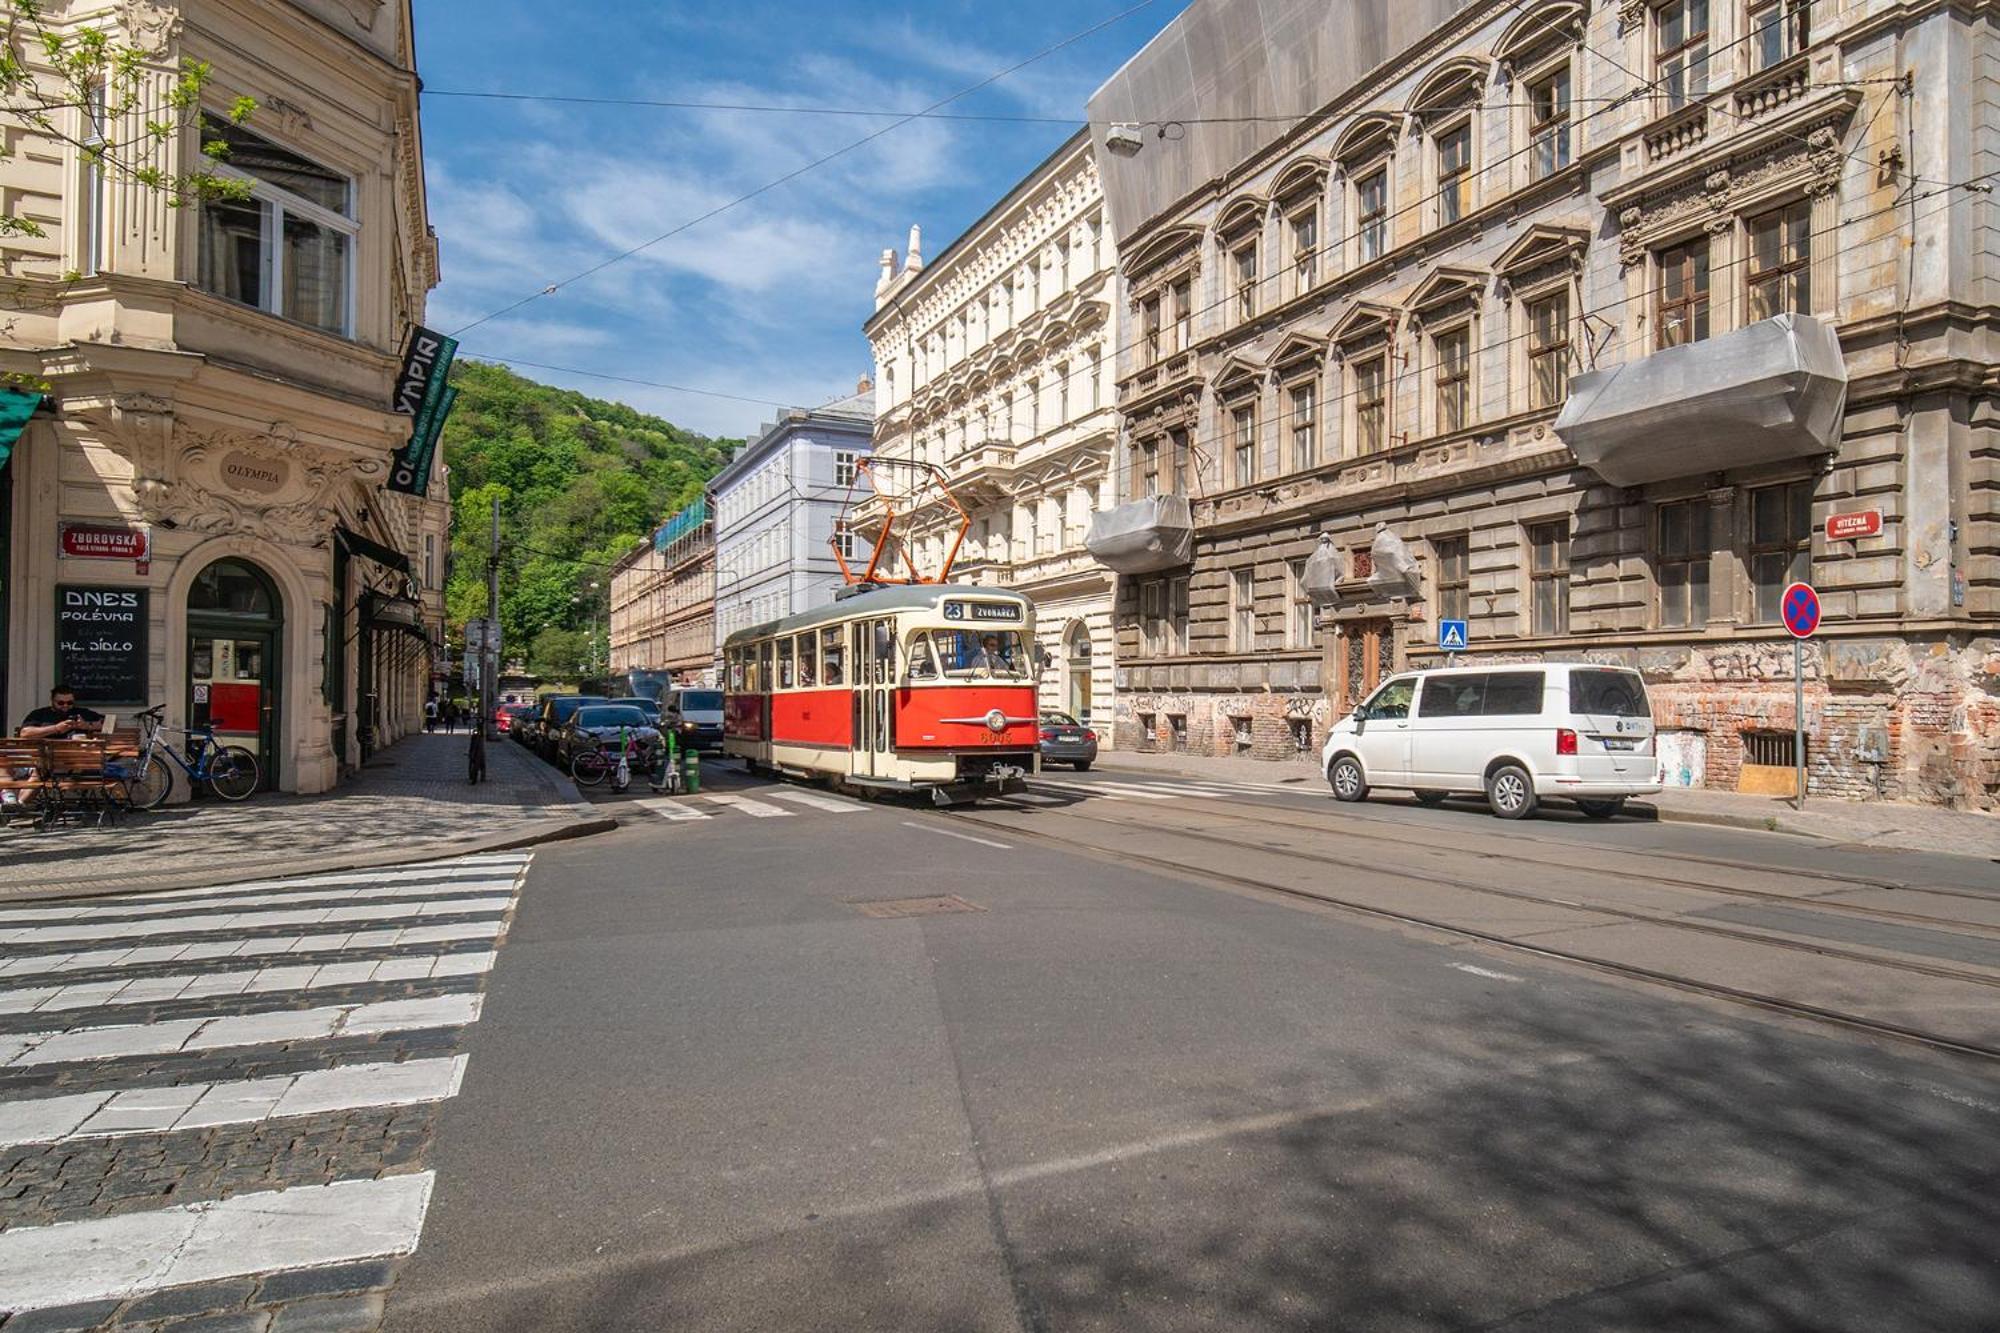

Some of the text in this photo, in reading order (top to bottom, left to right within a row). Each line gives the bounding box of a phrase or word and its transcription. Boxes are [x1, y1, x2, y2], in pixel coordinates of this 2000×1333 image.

[396, 336, 438, 416] YMPIA
[227, 464, 278, 483] OLYMPIA
[66, 591, 138, 607] DNES
[61, 608, 133, 621] POLÉVKA
[945, 604, 961, 618] 23
[60, 638, 133, 651] HL. JÍDLO
